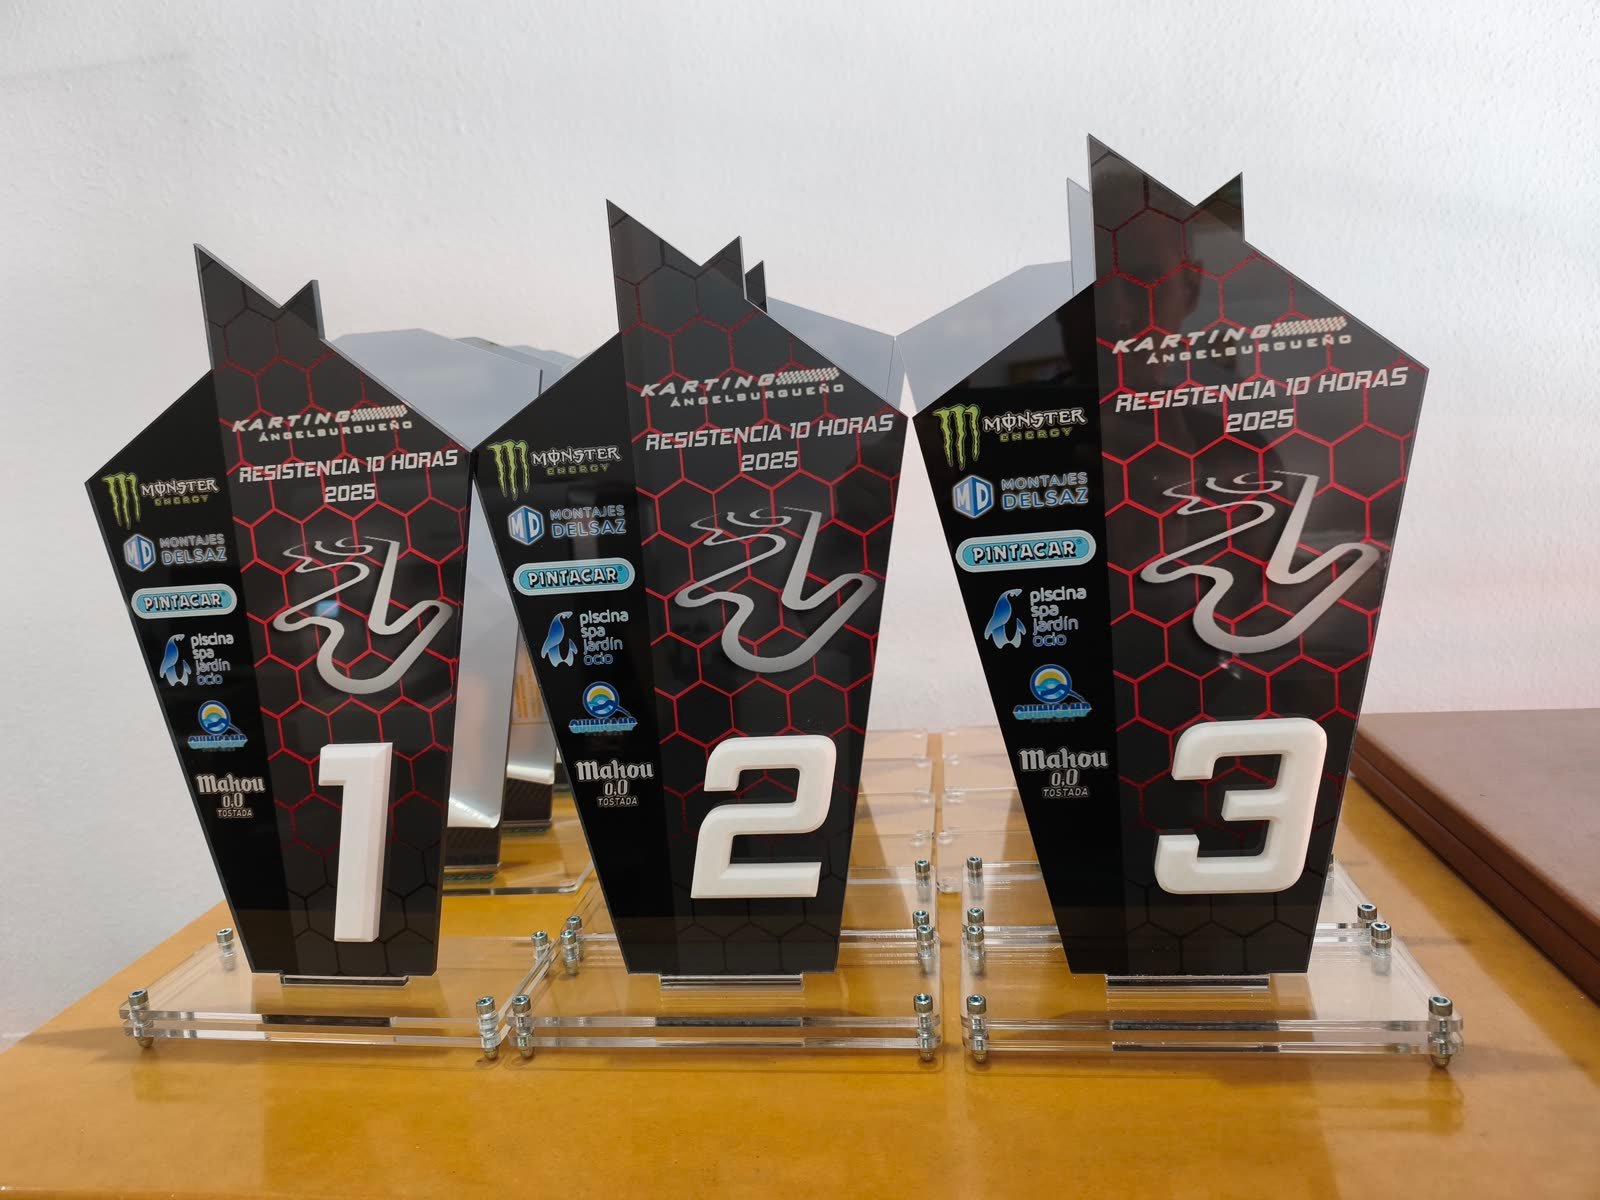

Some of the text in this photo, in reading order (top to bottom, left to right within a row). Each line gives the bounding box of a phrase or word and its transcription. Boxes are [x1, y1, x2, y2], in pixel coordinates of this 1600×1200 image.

[1112, 324, 1272, 354] KARTING
[640, 373, 776, 397] KARTING
[1115, 367, 1409, 413] RESISTENCIA 10 HORAS
[232, 410, 351, 432] KARTING
[1225, 409, 1295, 433] 2025
[645, 414, 894, 451] RESISTENCIA 10 HORAS
[1000, 427, 1072, 442] ENERGY
[239, 450, 458, 482] RESISTENCIA 10 HORAS
[547, 463, 609, 475] ENERGY
[741, 451, 798, 472] 2025
[1001, 472, 1088, 490] MONTAJES
[324, 483, 376, 503] 2025
[955, 482, 992, 515] MD
[1002, 488, 1089, 510] DELSAZ
[550, 505, 625, 520] MONTAJES
[510, 512, 542, 539] MD
[552, 519, 627, 538] DELSAZ
[159, 533, 225, 548] MONTAJES
[127, 540, 153, 568] MD
[163, 547, 227, 565] DELSAZ
[972, 541, 1075, 566] PINTACAR
[527, 568, 618, 587] PINTACAR
[143, 593, 222, 611] PINTACAR
[1030, 587, 1087, 605] piscina
[579, 610, 629, 627] piscina
[1031, 603, 1059, 619] spa
[580, 625, 605, 640] spa
[1031, 616, 1078, 634] jardín
[191, 634, 234, 649] piscina
[582, 637, 623, 654] jardín
[1032, 631, 1066, 646] ocio
[193, 648, 214, 662] spa
[583, 652, 613, 665] ocio
[194, 658, 231, 674] jardín
[196, 673, 223, 686] ocio
[1019, 748, 1109, 770] Mahou
[575, 760, 654, 780] Mahou
[196, 774, 265, 793] Mahou
[1043, 787, 1088, 797] TOSTADA
[598, 797, 638, 806] TOSTADA
[1154, 717, 1327, 894] 3
[217, 809, 252, 817] TOSTADA
[690, 734, 837, 898] 2
[318, 742, 393, 942] 1
